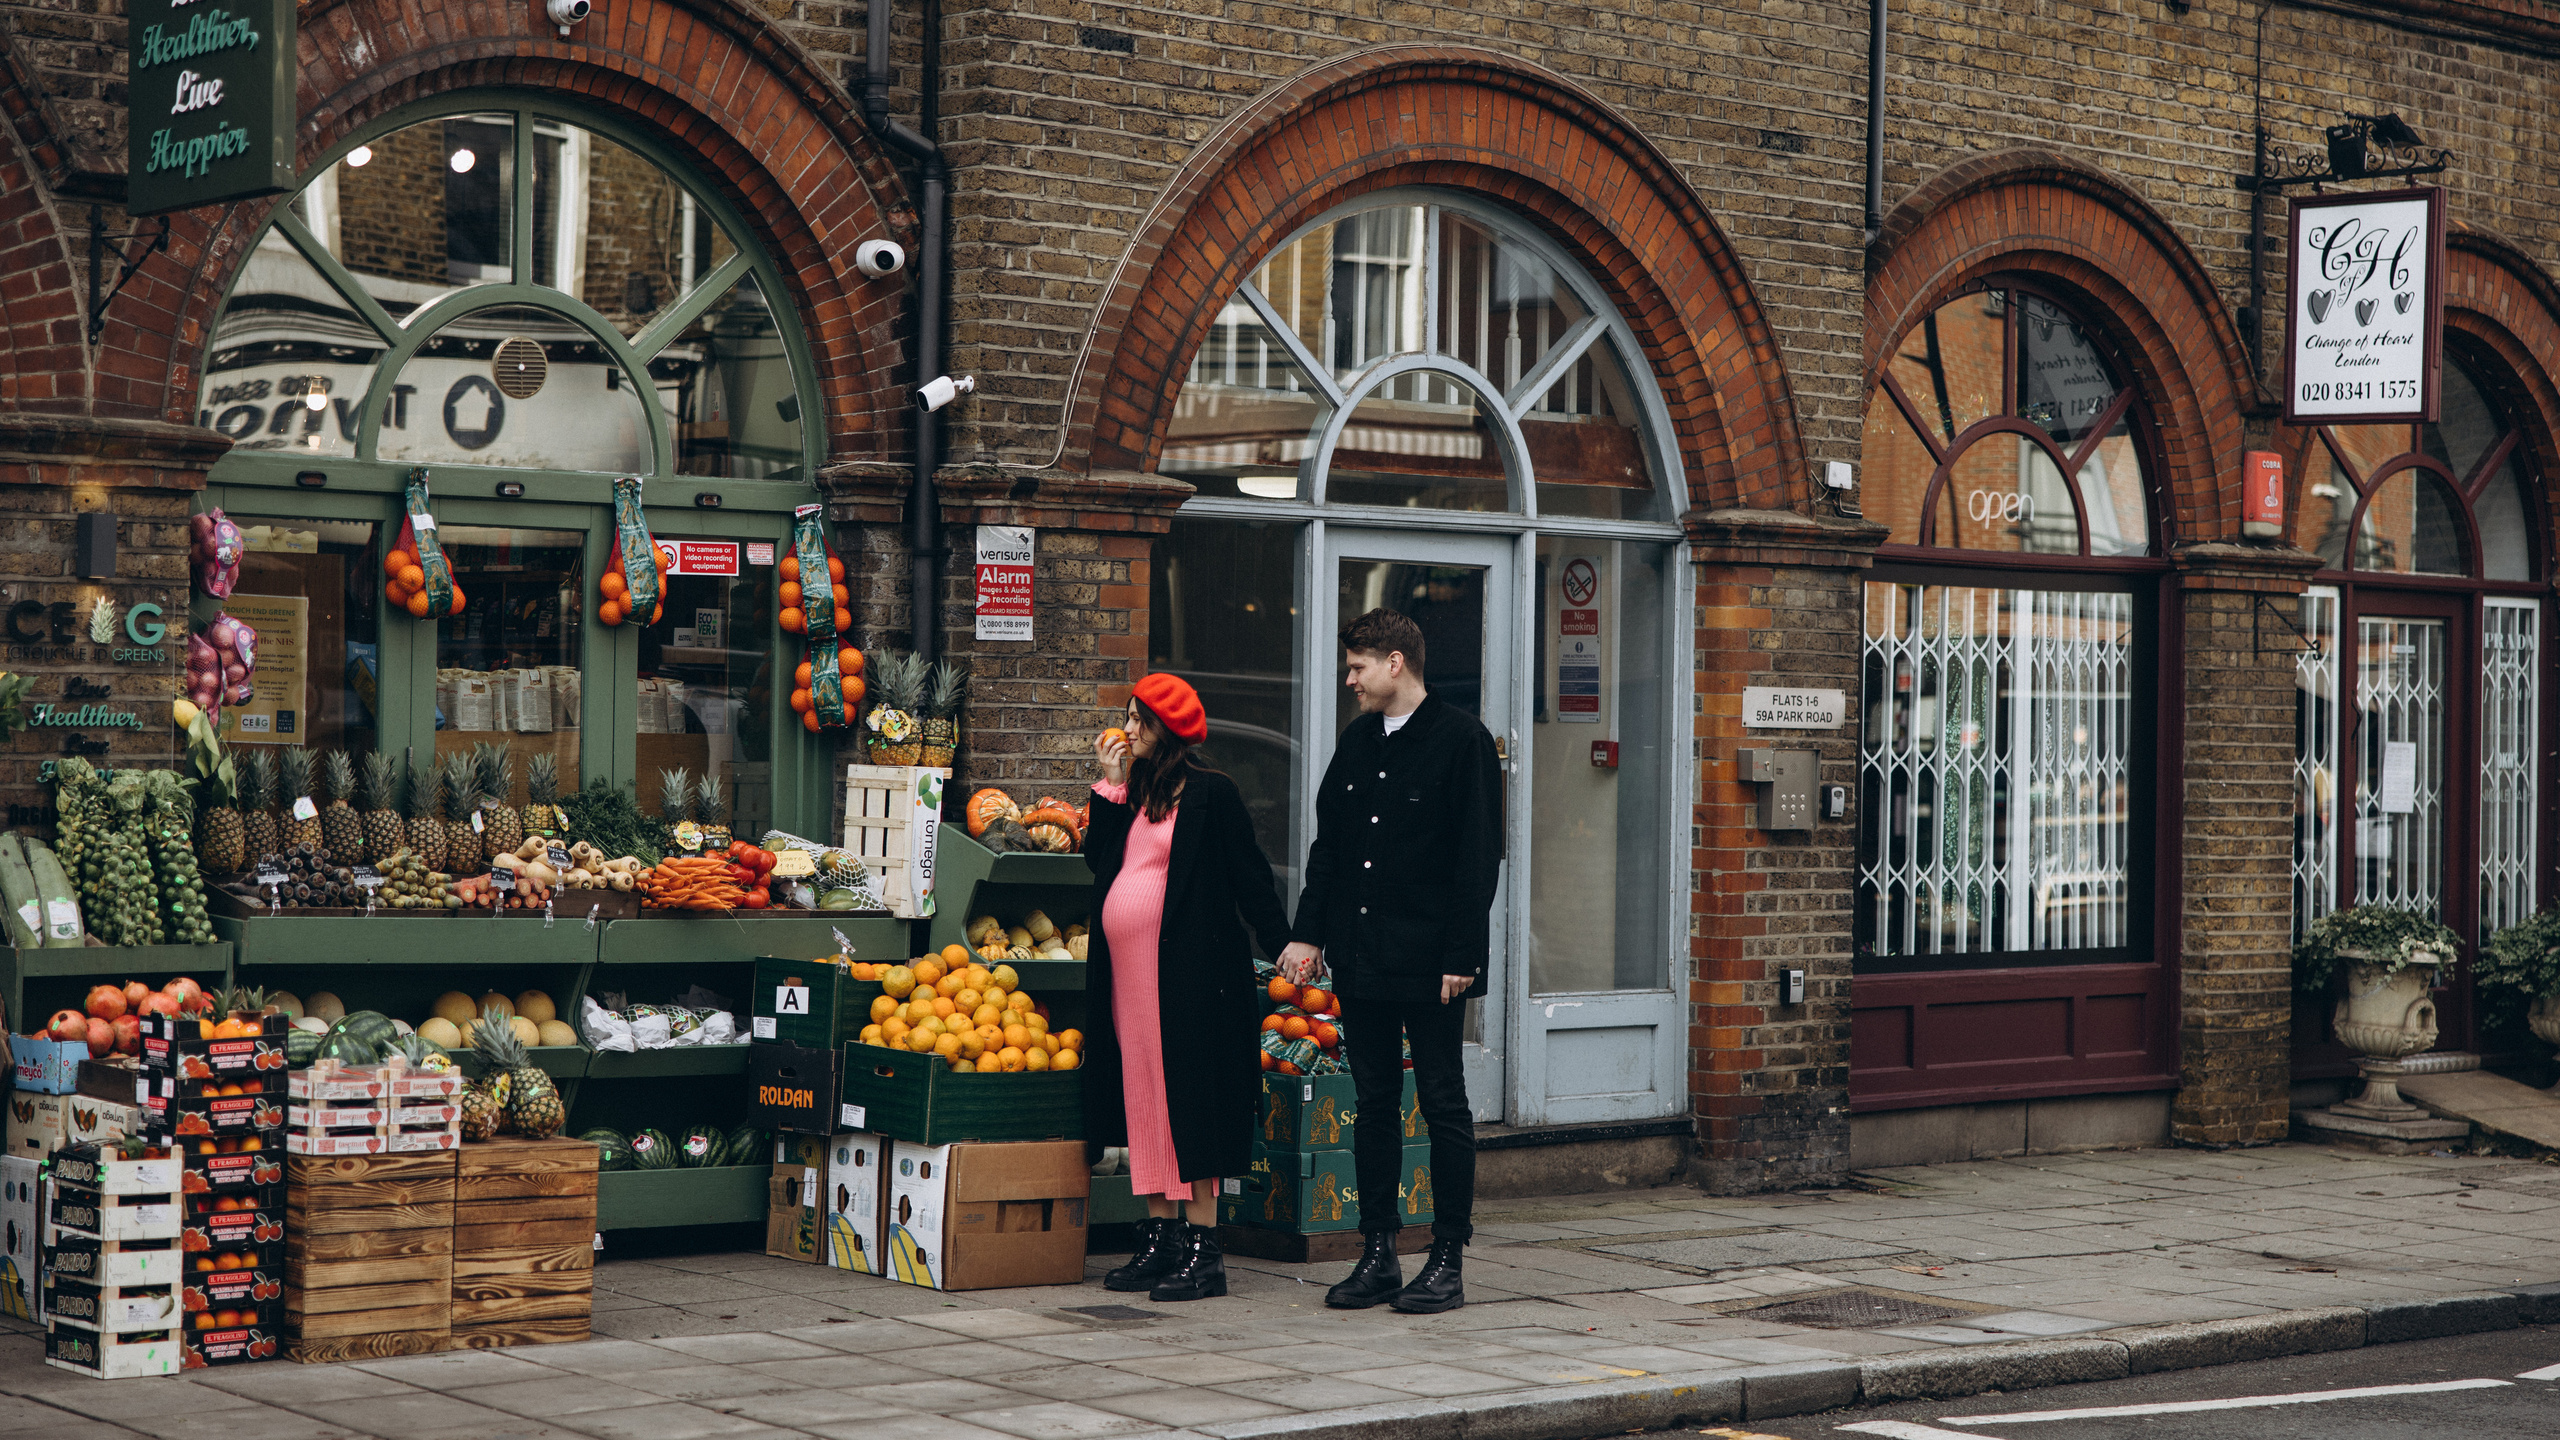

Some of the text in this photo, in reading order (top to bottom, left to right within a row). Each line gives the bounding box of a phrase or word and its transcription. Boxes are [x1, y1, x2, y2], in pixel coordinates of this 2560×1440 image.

[138, 9, 259, 69] Healthier,
[171, 70, 225, 115] Live
[146, 121, 250, 179] Happier
[2306, 329, 2414, 352] Change of Heart
[2334, 352, 2380, 368] London
[2302, 380, 2416, 401] 020 8341 1575
[2262, 460, 2280, 469] COBRA
[703, 555, 732, 563] recording
[980, 550, 1030, 560] verisure
[980, 567, 1030, 584] Alarm
[980, 586, 1002, 594] Images
[992, 594, 1030, 606] recording
[269, 608, 296, 616] GREENS
[698, 613, 712, 624] ECO
[1574, 612, 1585, 620] No
[698, 624, 711, 635] VER
[1563, 623, 1596, 634] smoking
[261, 637, 274, 645] the
[112, 648, 165, 662] GREENS
[1772, 694, 1819, 707] FLATS 1-6
[29, 703, 144, 731] Healthier,
[1756, 710, 1833, 723] 59A PARK ROAD
[920, 820, 935, 879] tomega
[783, 988, 799, 1010] A
[760, 1086, 813, 1108] ROLDAN
[102, 1110, 124, 1124] tomega
[56, 1159, 94, 1181] PARDO
[62, 1206, 94, 1226] PARDO
[799, 1207, 815, 1254] Fyffe
[54, 1253, 91, 1272] PARDO
[57, 1296, 94, 1316] PARDO
[57, 1341, 92, 1361] PARDO
